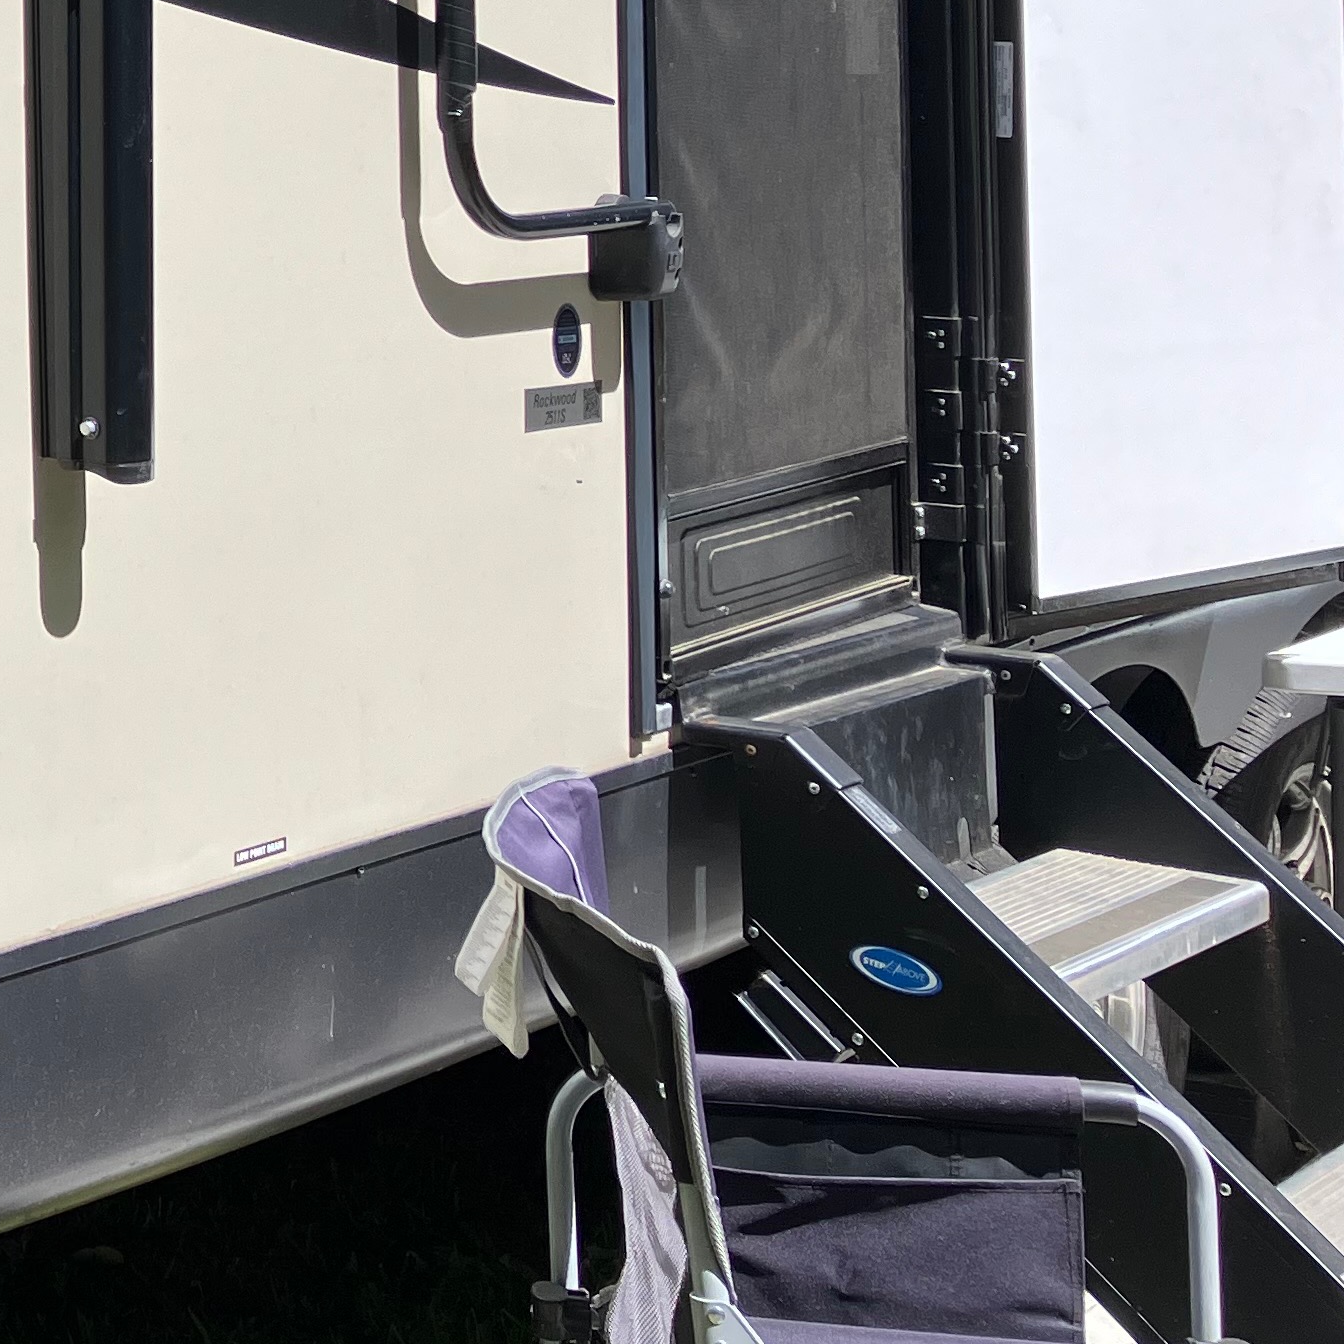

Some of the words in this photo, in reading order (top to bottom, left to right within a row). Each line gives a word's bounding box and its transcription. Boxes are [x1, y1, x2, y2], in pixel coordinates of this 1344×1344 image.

[533, 389, 577, 408] Rockwood
[862, 956, 886, 970] STEP
[893, 963, 926, 982] ABOVE
